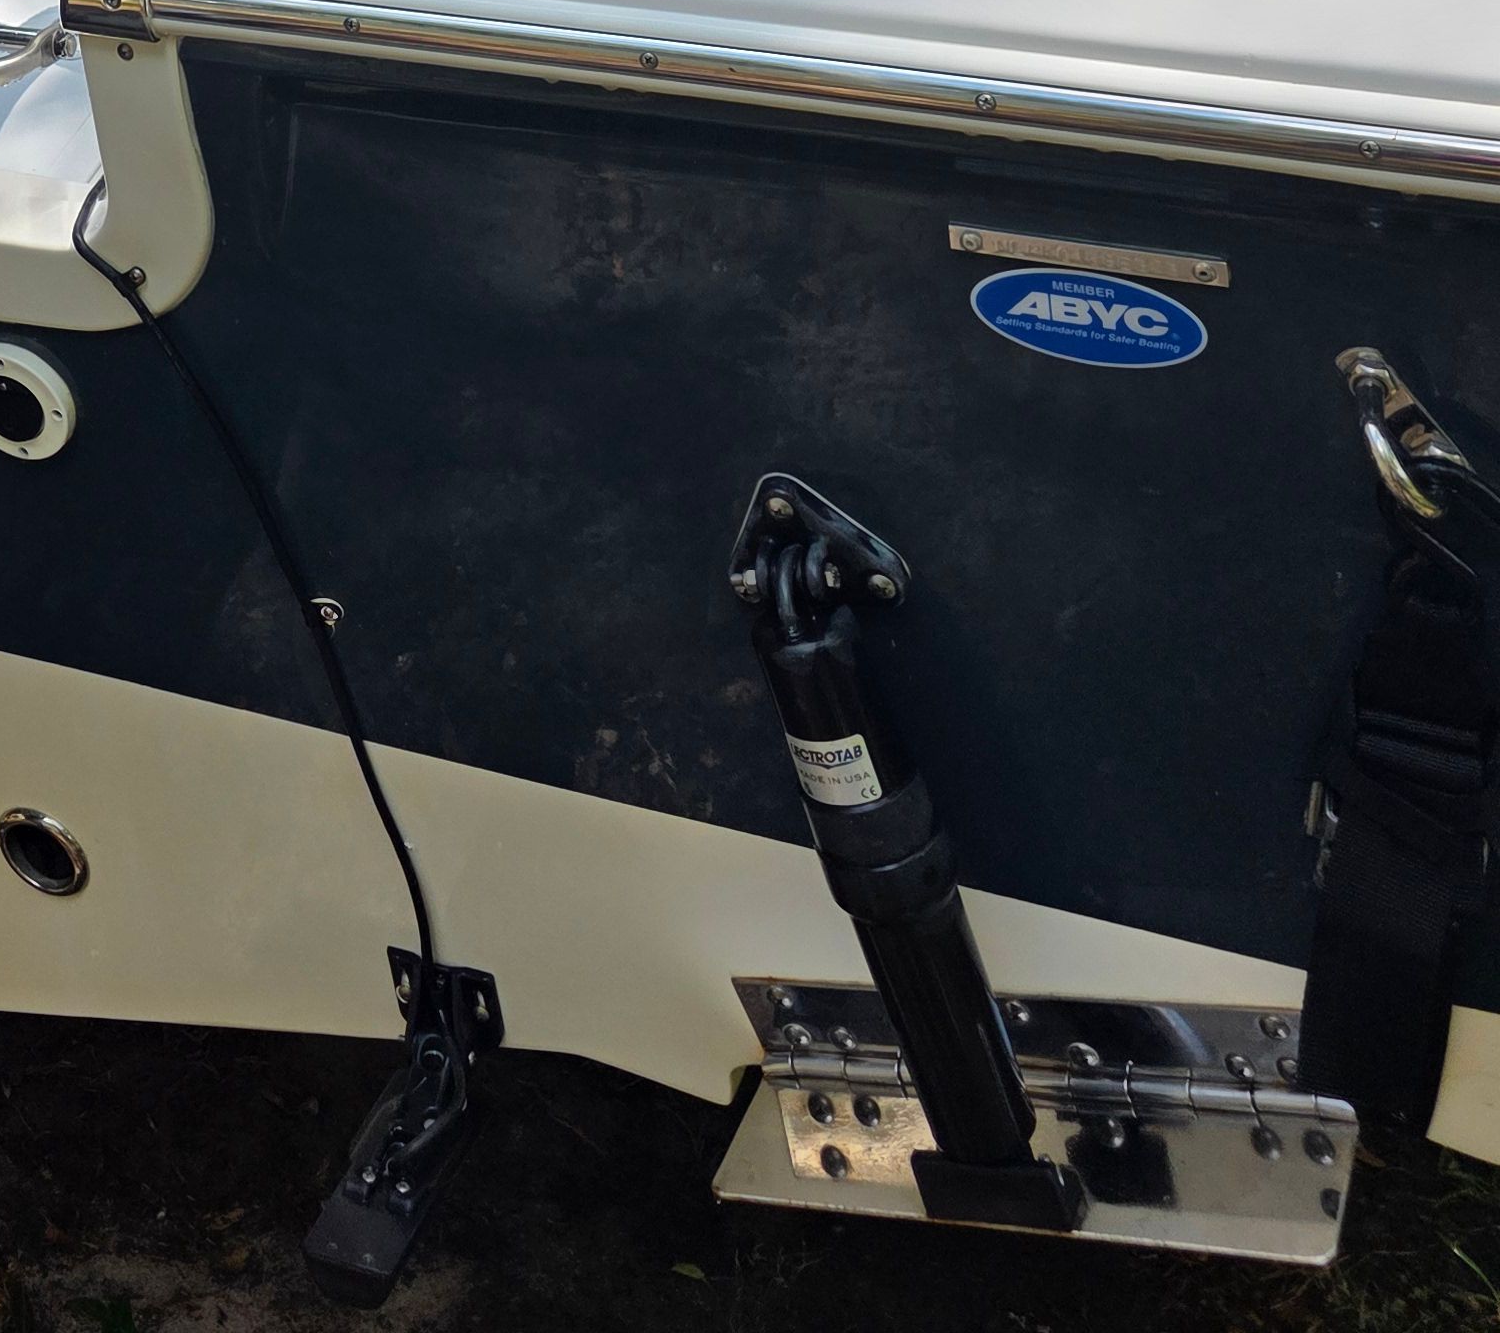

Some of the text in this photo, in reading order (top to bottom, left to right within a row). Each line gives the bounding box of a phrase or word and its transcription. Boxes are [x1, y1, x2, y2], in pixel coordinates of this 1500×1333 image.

[1051, 280, 1115, 299] MEMBER
[1007, 291, 1169, 337] ABYC
[995, 315, 1181, 354] Setting Standards for Safer Boating
[828, 777, 841, 785] IN
[844, 771, 871, 784] USA
